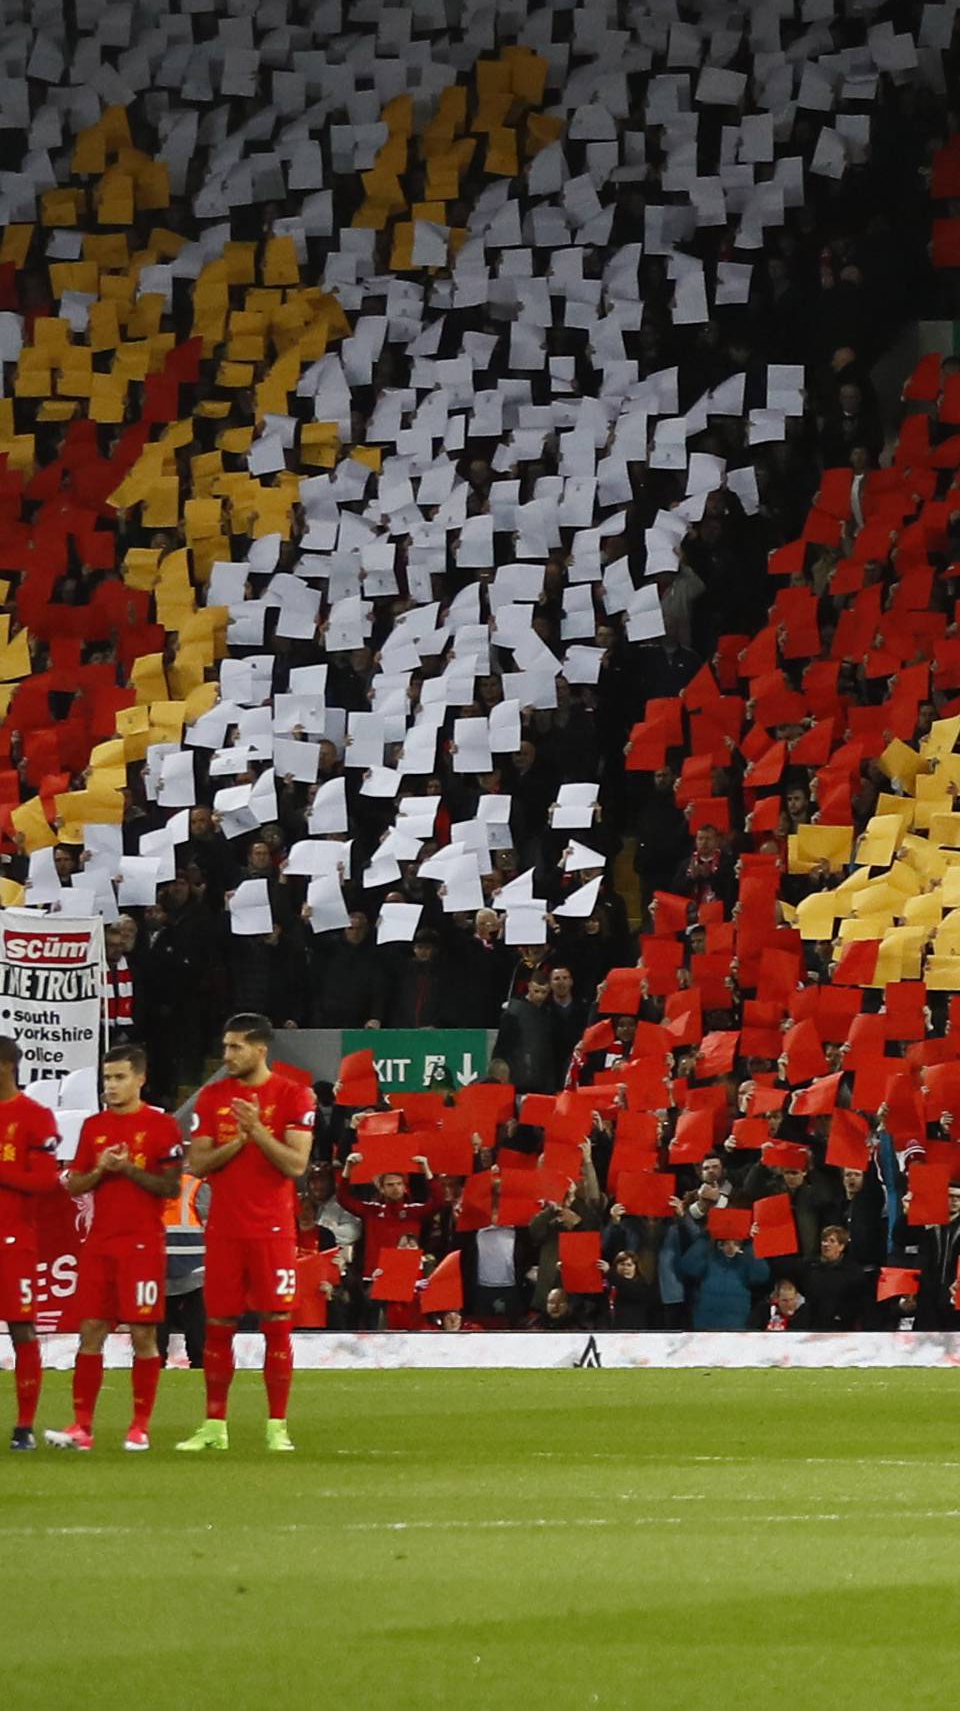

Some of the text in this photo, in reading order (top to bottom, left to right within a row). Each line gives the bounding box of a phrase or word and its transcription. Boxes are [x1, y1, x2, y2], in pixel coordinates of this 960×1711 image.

[35, 967, 99, 1001] TRUTH
[13, 1010, 61, 1025] south
[13, 1026, 94, 1042] yorkshire
[18, 1047, 64, 1063] olice
[372, 1058, 412, 1083] XIT
[19, 1278, 33, 1304] 5
[136, 1280, 158, 1306] 10
[275, 1268, 297, 1295] 23
